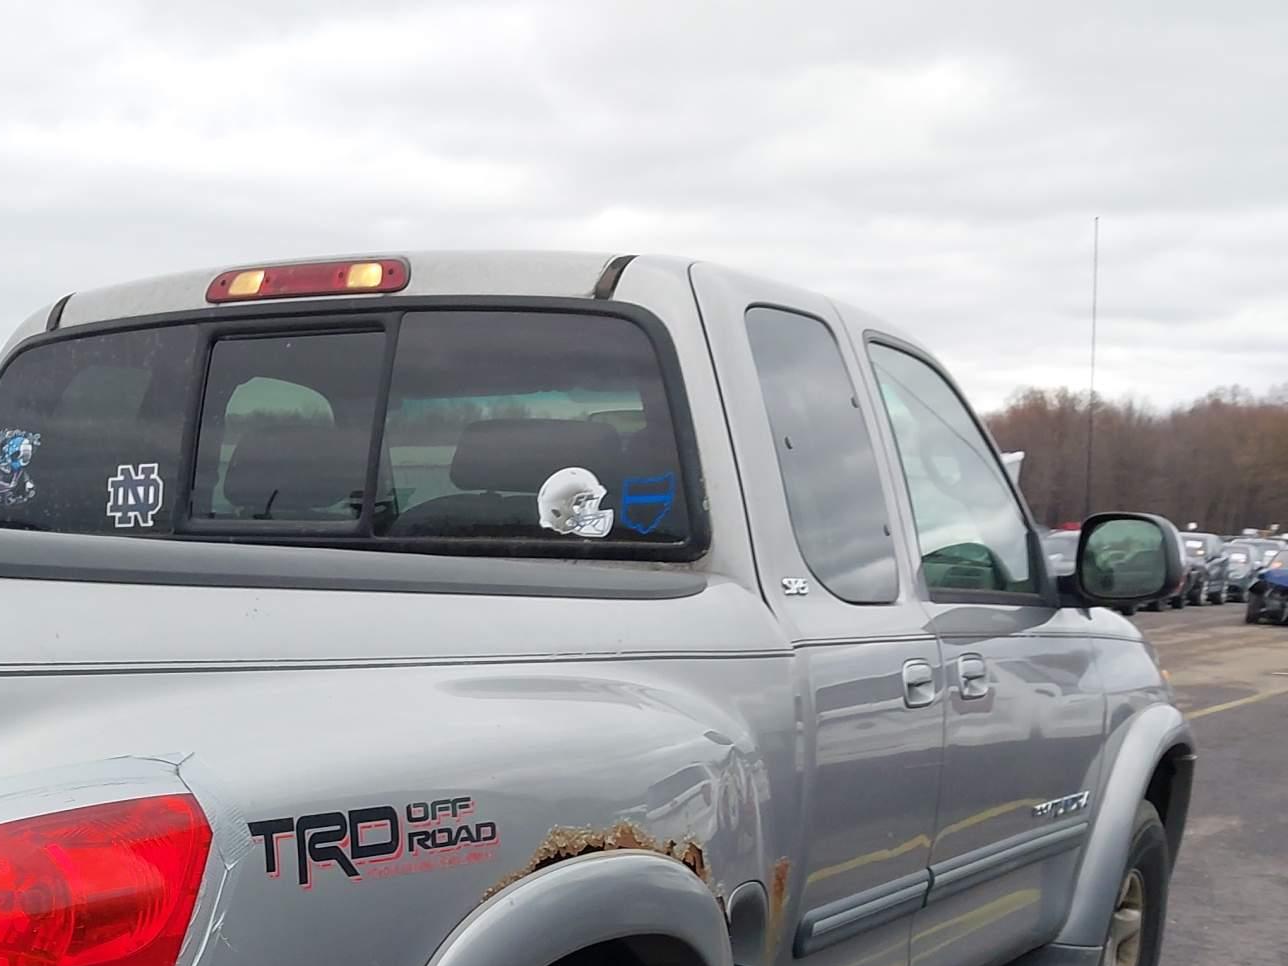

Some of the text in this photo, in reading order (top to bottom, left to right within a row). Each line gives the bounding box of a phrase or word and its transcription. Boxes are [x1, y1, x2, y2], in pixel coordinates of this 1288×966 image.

[406, 797, 474, 826] OFF
[247, 805, 401, 887] TRD
[407, 822, 499, 854] ROAD
